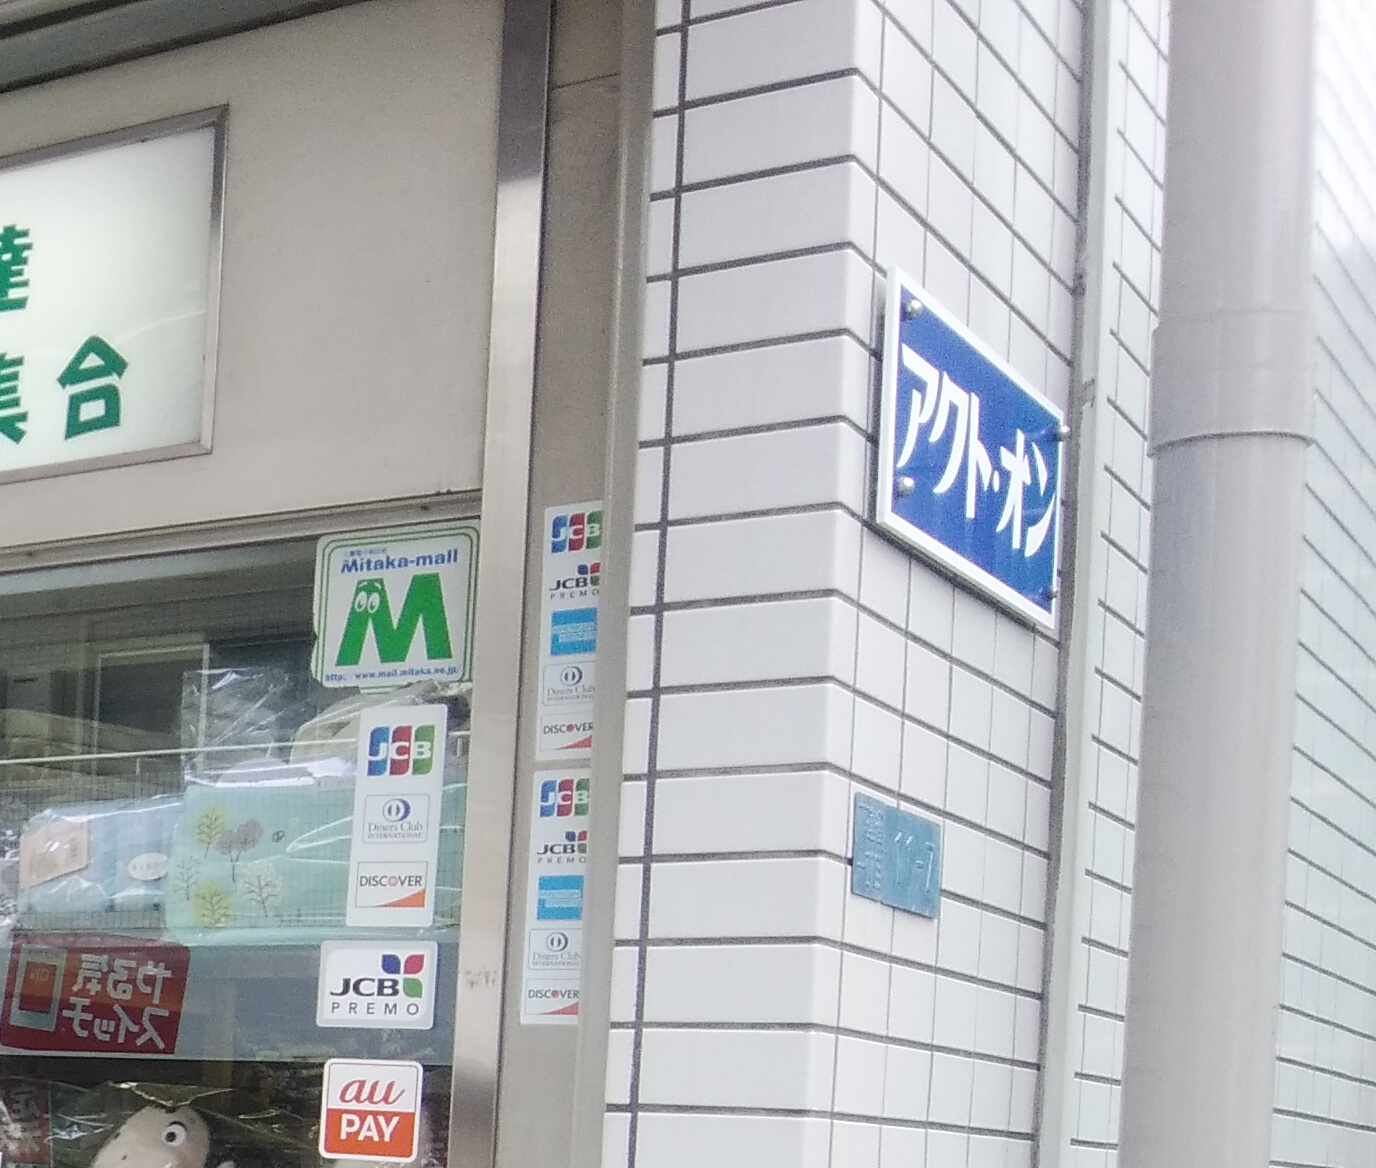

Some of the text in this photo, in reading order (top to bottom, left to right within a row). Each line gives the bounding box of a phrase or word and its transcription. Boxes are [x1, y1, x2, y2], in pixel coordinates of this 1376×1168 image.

[896, 343, 1055, 558] アクト・オン
[341, 548, 458, 573] Mitaka-mall
[549, 578, 588, 591] JCB
[368, 821, 423, 833] Diners Club
[537, 843, 576, 855] JCB
[359, 875, 422, 887] DISCOVER
[330, 978, 400, 997] JCB
[331, 1003, 420, 1016] PREMO
[338, 1079, 405, 1105] au
[340, 1114, 400, 1142] PAY
